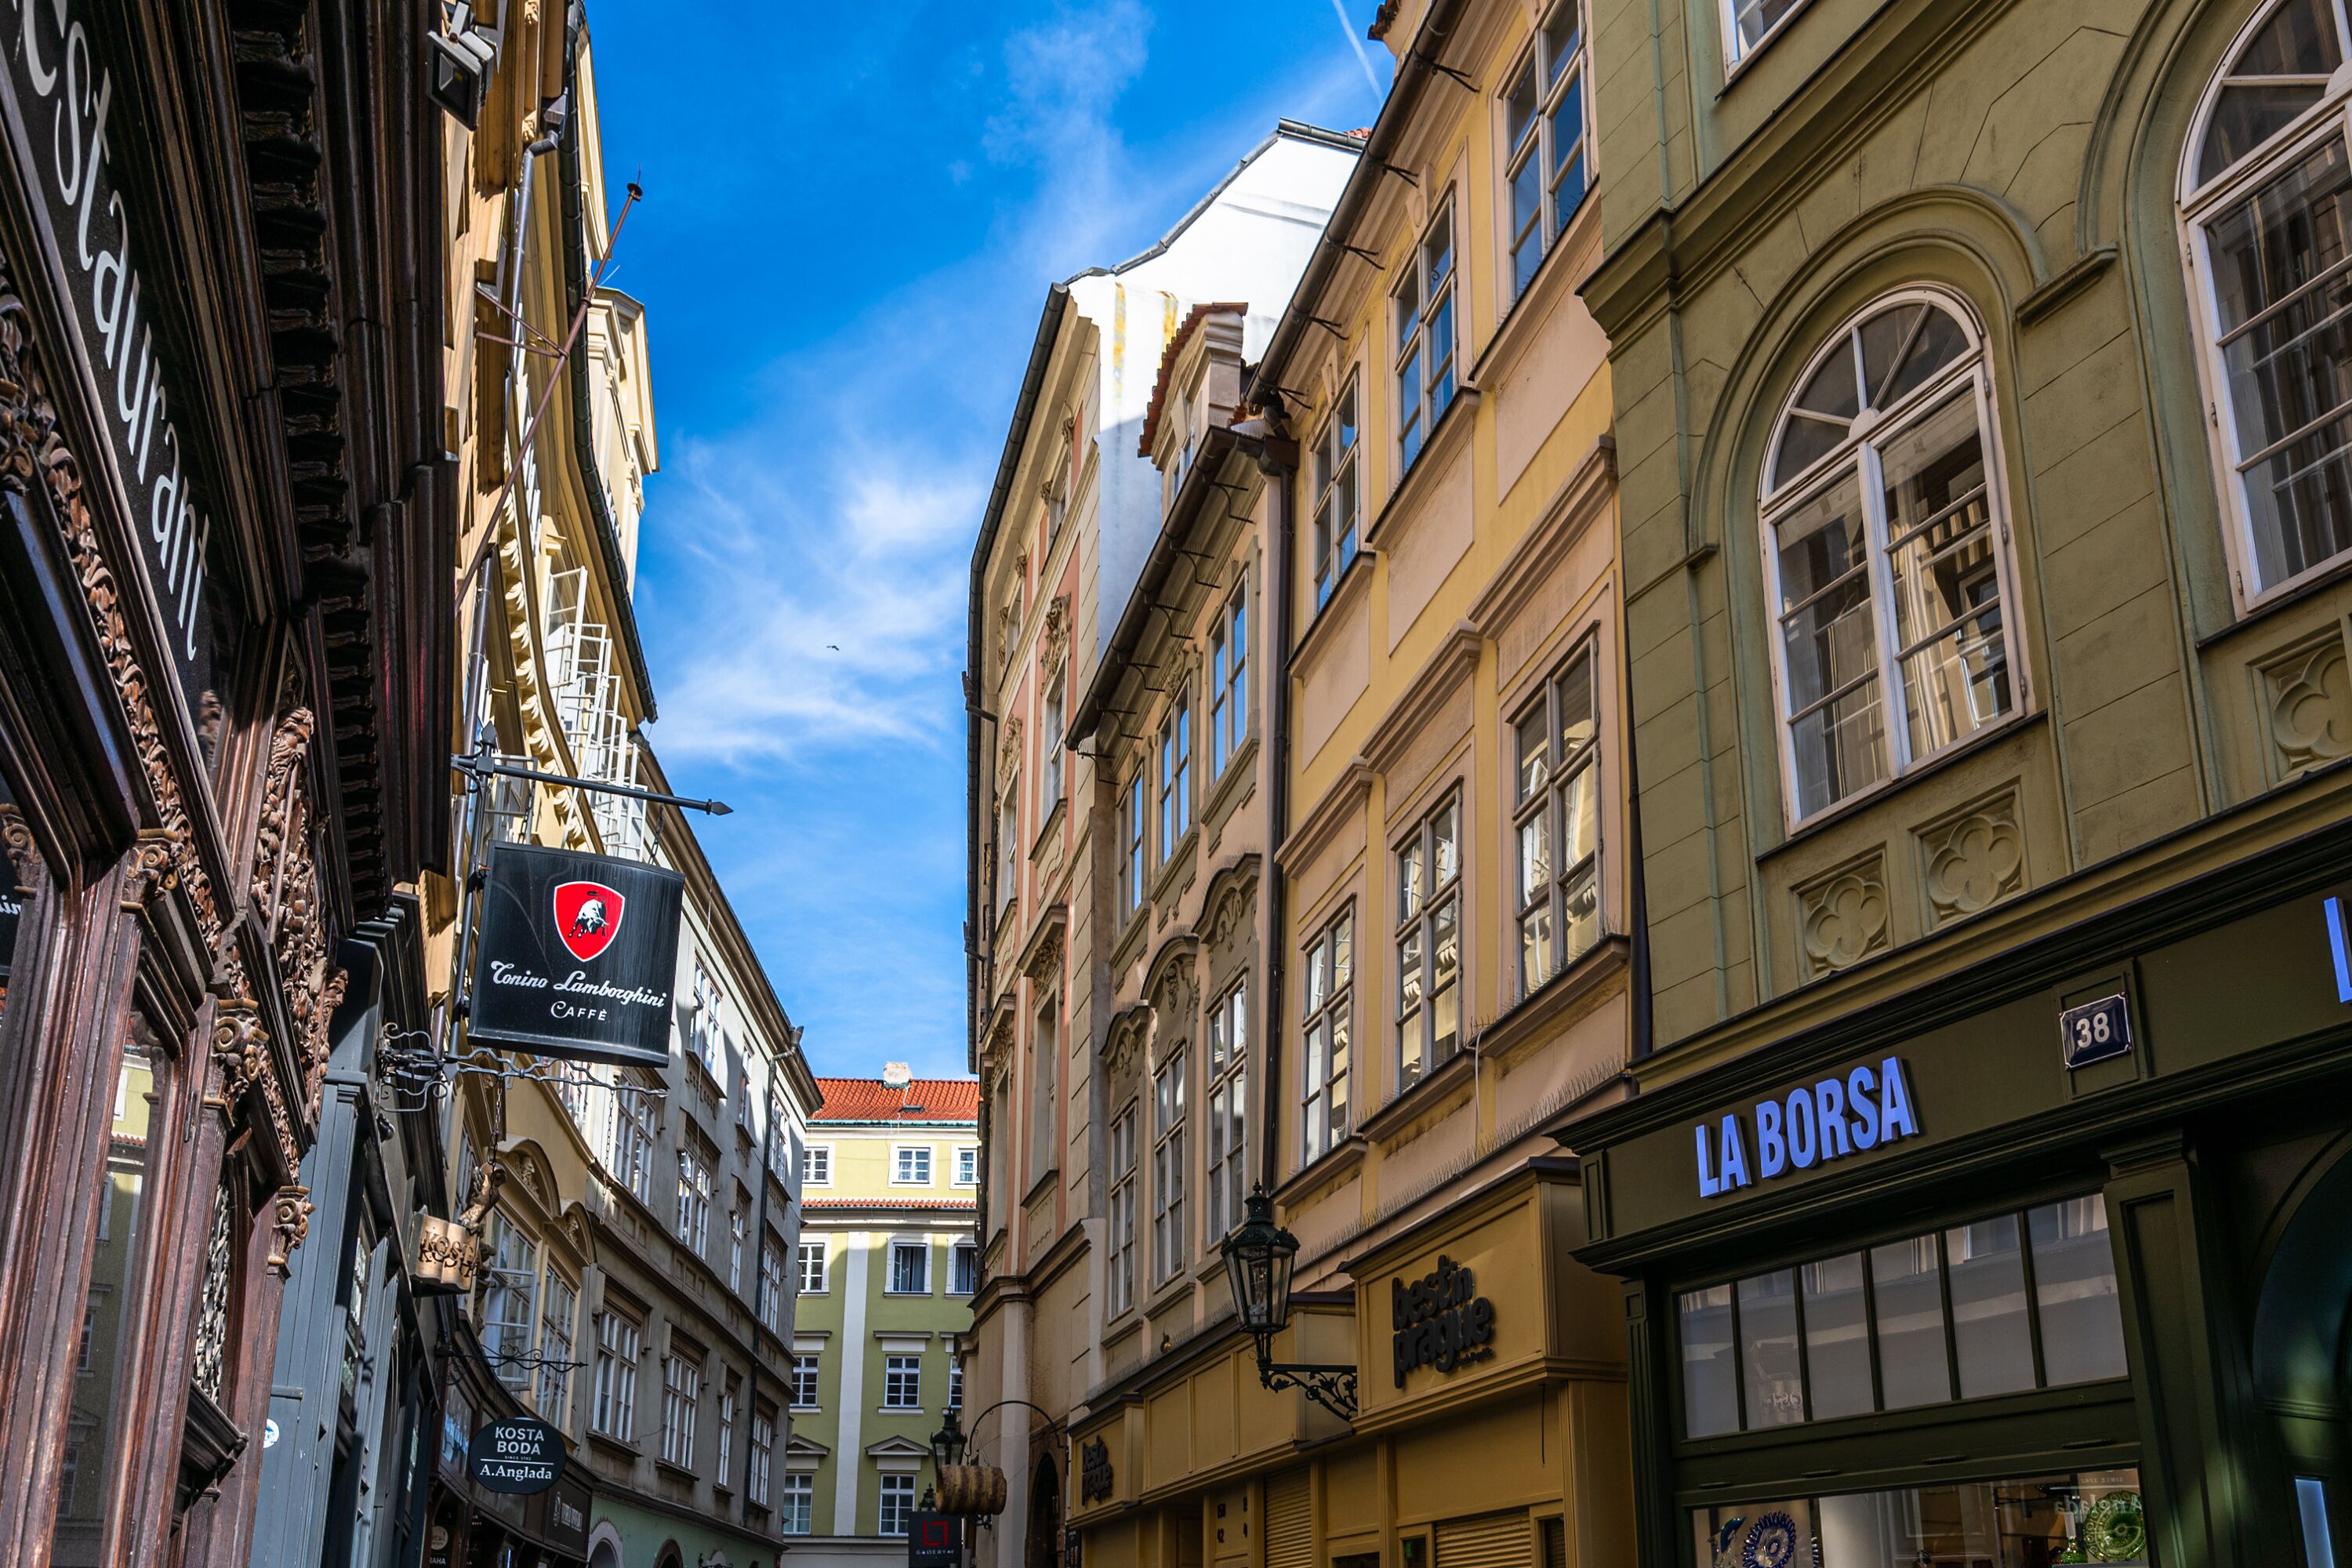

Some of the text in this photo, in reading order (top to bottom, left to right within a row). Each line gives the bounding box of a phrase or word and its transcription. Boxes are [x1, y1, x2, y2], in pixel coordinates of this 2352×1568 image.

[491, 960, 667, 1007] Tonino Lamborghini
[551, 1000, 608, 1022] CAFFÈ
[2076, 1011, 2111, 1049] 38
[1694, 1055, 1918, 1198] LA BORSA
[1392, 1254, 1452, 1331] best
[1392, 1297, 1493, 1388] prague
[495, 1426, 544, 1442] KOSTA
[496, 1441, 541, 1455] BODA
[479, 1464, 553, 1482] A.Anglada
